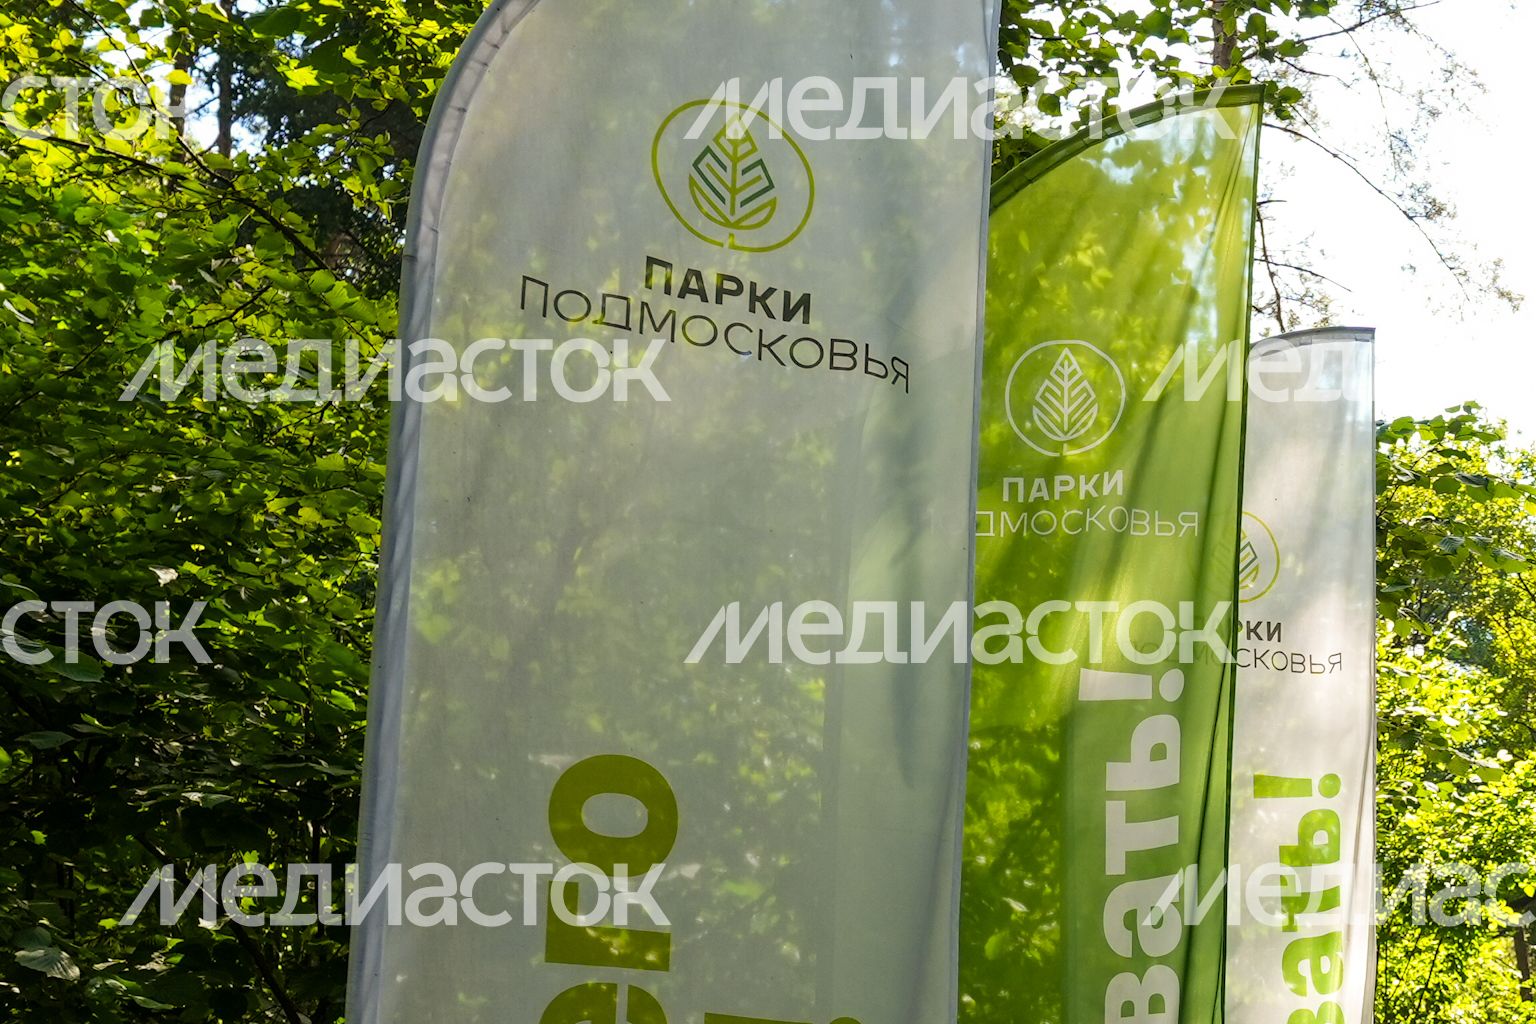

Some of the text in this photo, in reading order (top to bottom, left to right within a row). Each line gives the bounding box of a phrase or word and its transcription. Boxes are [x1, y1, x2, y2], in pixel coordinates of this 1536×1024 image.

[644, 254, 812, 325] ПАРКИ
[520, 274, 910, 395] ПОДМОСКОВЬЯ
[1002, 468, 1125, 503] ПАРКИ
[975, 504, 1199, 538] ДМОСКОВЬЯ
[1235, 647, 1343, 675] СКОВЬЯ
